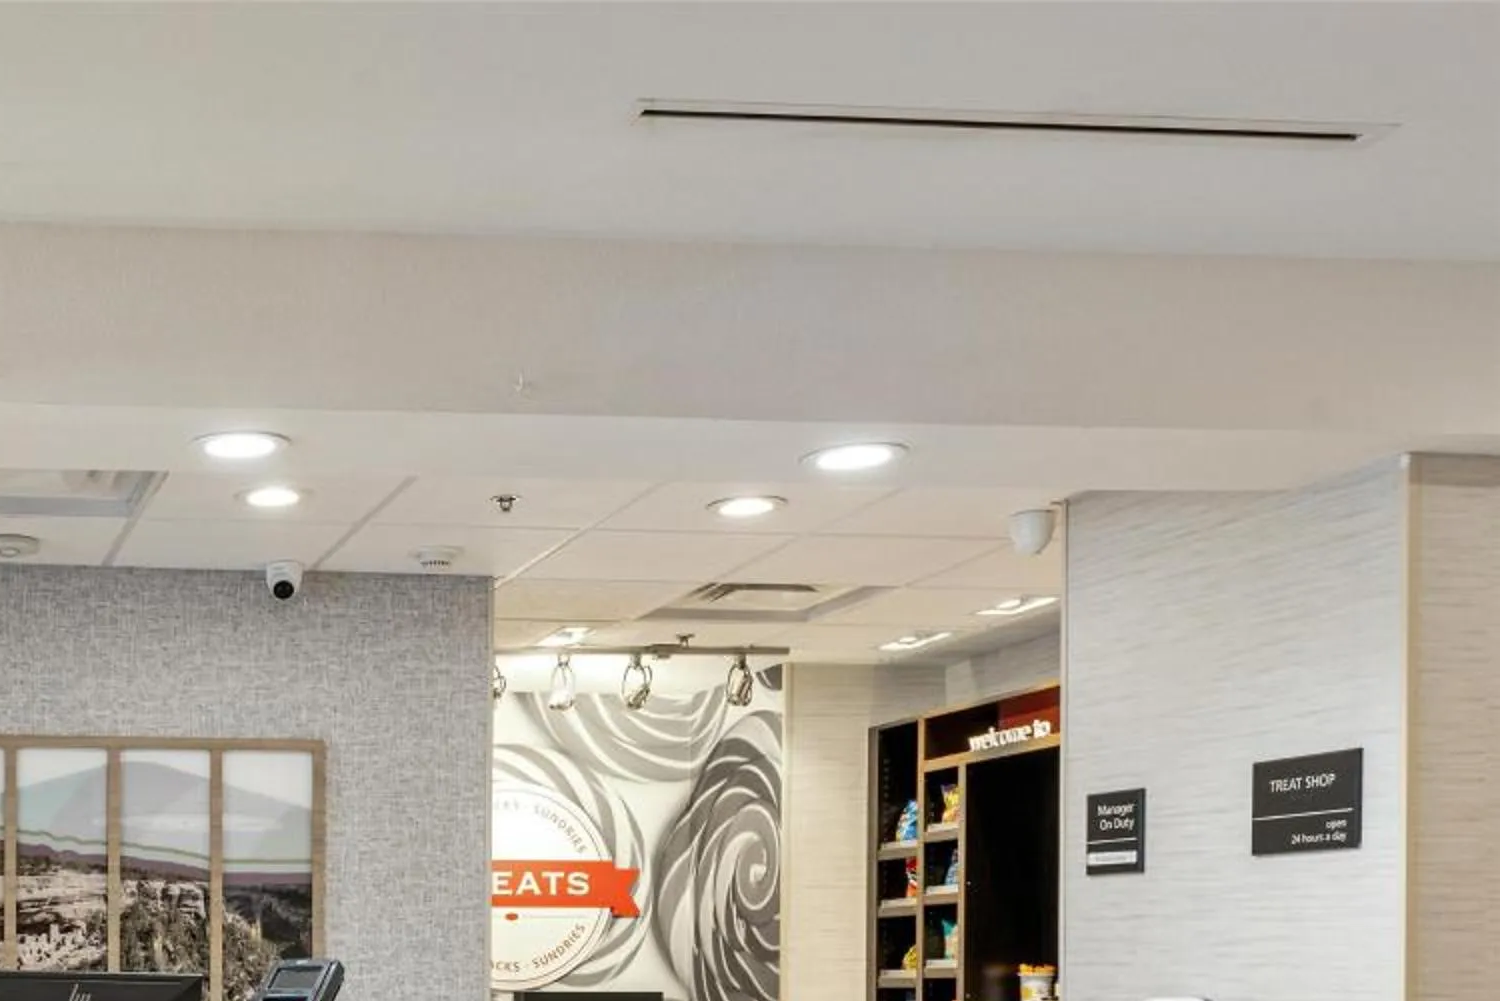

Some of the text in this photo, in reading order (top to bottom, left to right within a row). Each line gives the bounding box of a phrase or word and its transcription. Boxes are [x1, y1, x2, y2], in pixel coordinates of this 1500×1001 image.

[969, 719, 1051, 752] welcome to
[1269, 773, 1336, 793] TREAT SHOP
[1097, 804, 1134, 817] Manager
[533, 803, 588, 854] SUNDRIES
[1100, 817, 1134, 831] On Duty
[1325, 819, 1347, 830] open
[1302, 833, 1324, 843] hours
[1332, 829, 1347, 843] day
[491, 923, 586, 973] CKS SUNDRIES
